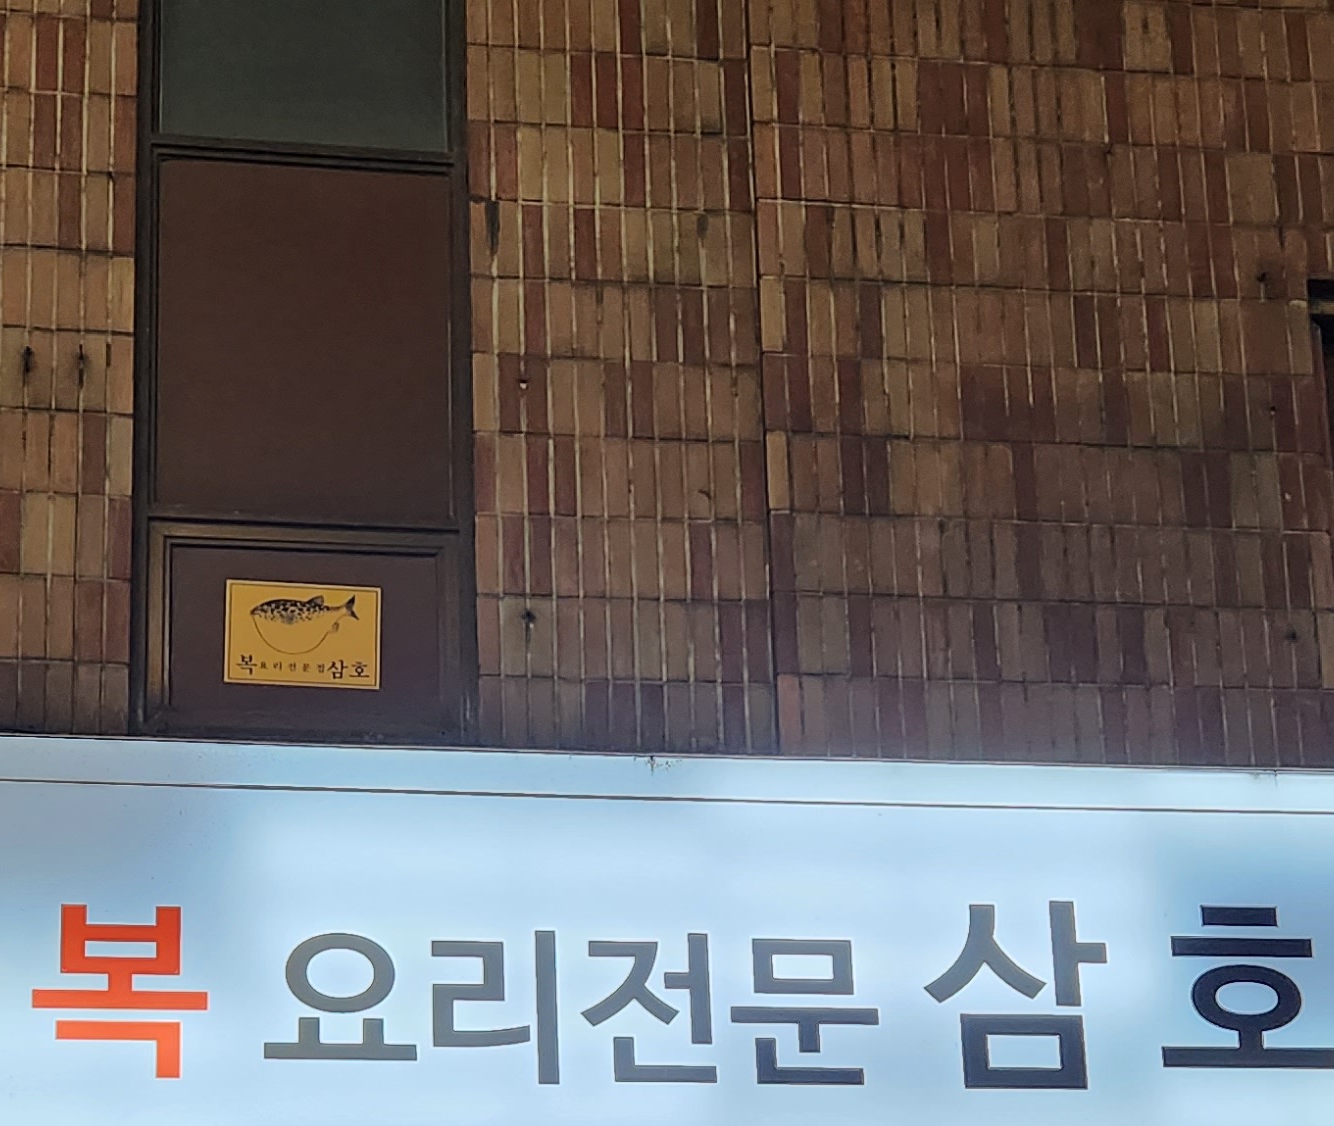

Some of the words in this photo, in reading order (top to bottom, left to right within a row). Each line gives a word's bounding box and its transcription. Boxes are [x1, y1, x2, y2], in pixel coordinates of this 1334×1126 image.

[236, 654, 258, 675] 복
[327, 659, 370, 679] 삼호
[31, 902, 209, 1080] 복
[263, 928, 881, 1088] 요리전문
